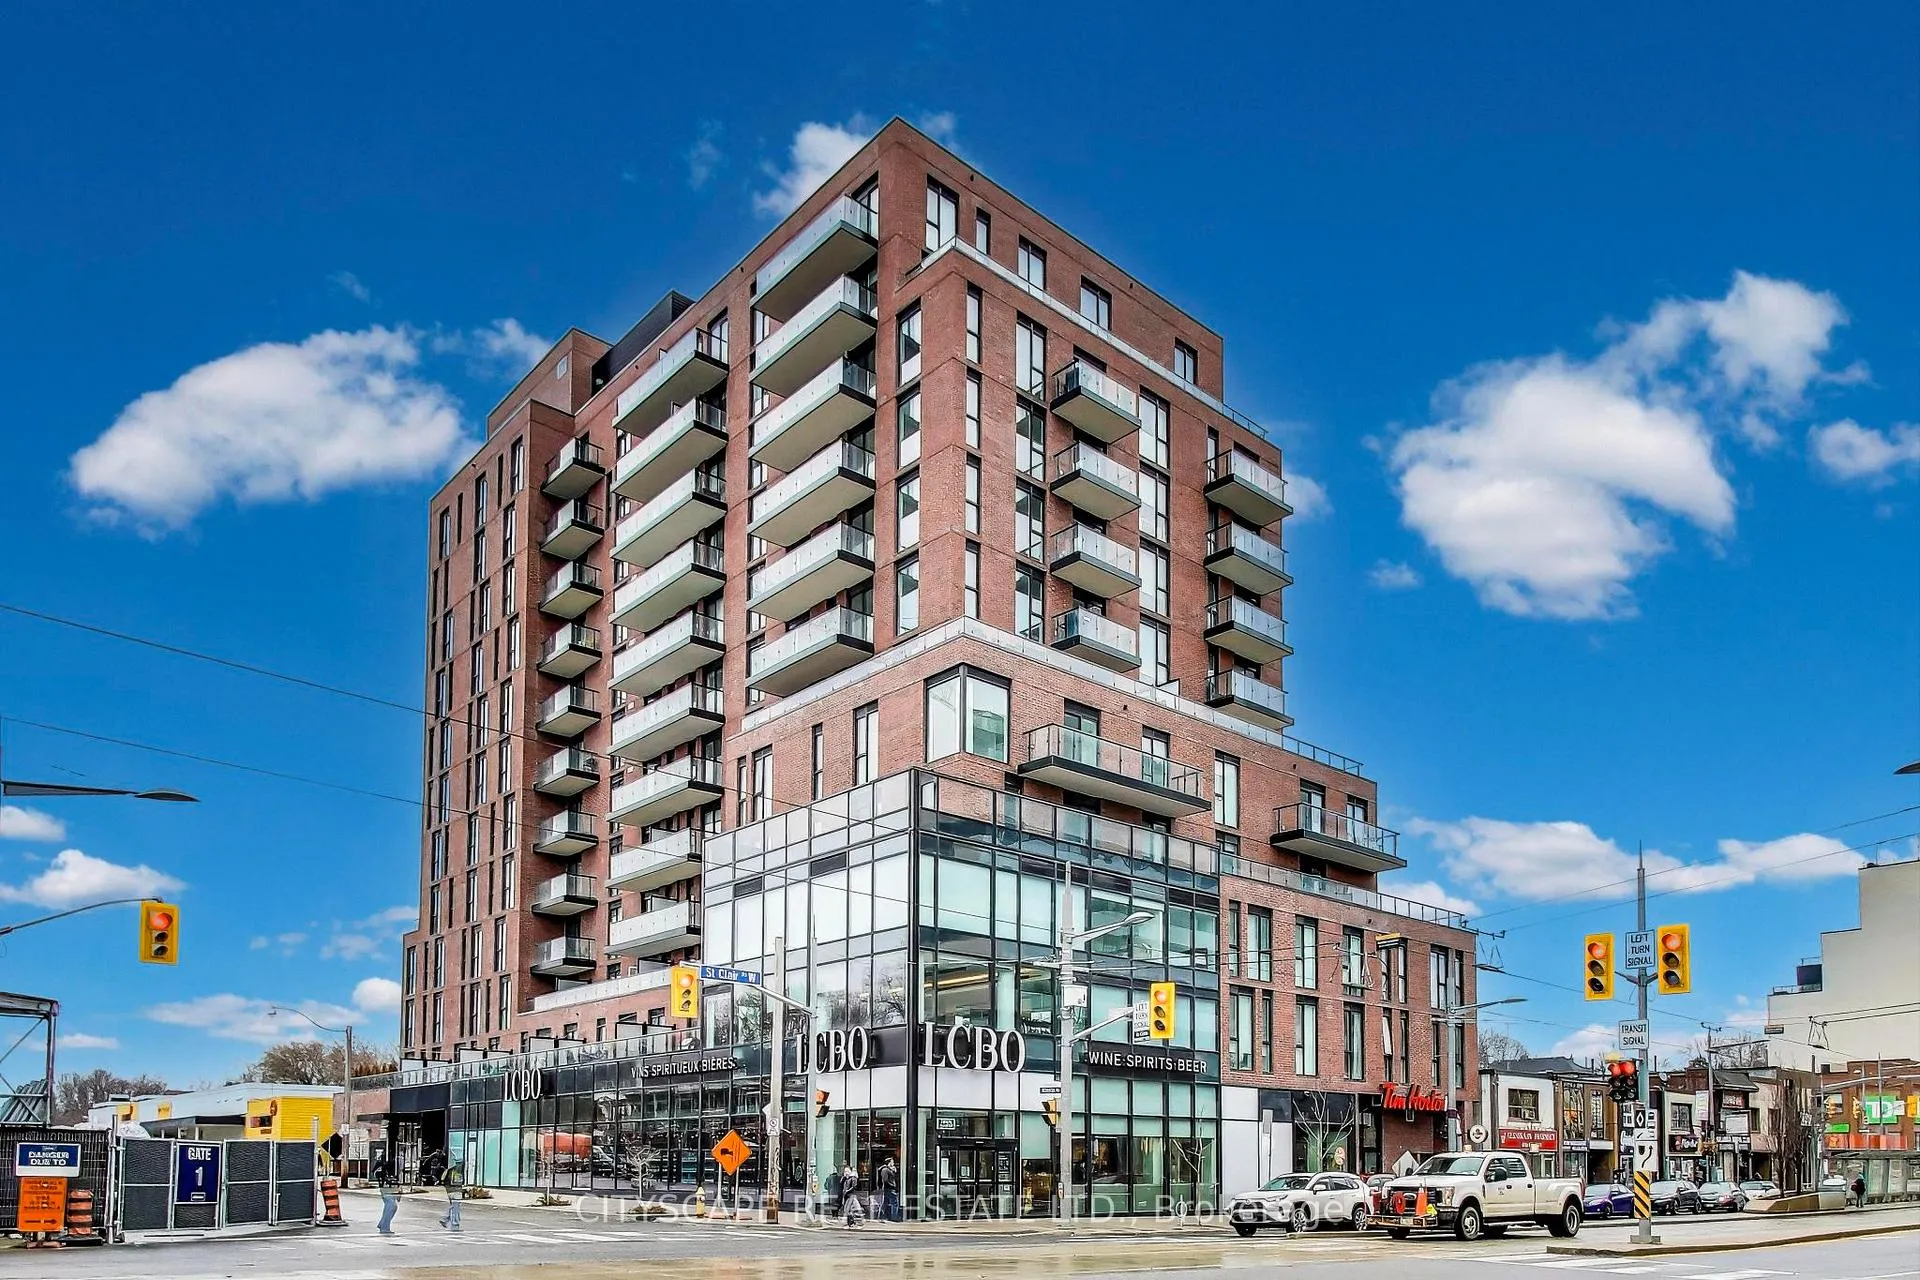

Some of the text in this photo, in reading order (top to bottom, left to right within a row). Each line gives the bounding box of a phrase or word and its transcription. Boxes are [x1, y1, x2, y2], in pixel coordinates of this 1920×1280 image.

[1630, 933, 1649, 944] LEFT
[1630, 944, 1651, 955] TURN
[1627, 958, 1653, 967] SIGNAL
[1621, 1023, 1647, 1034] TRANSIT
[795, 1026, 869, 1076] LCBO
[922, 1021, 1026, 1073] LCBO
[631, 1056, 734, 1079] VINS SPIRITUEUX BIÈRES
[1088, 1051, 1208, 1074] WINE SPIRITS BEER
[504, 1069, 541, 1101] LCBO
[1383, 1082, 1406, 1110] Tim
[53, 1158, 67, 1166] TO
[188, 1147, 211, 1160] GATE
[195, 1166, 203, 1186] 1
